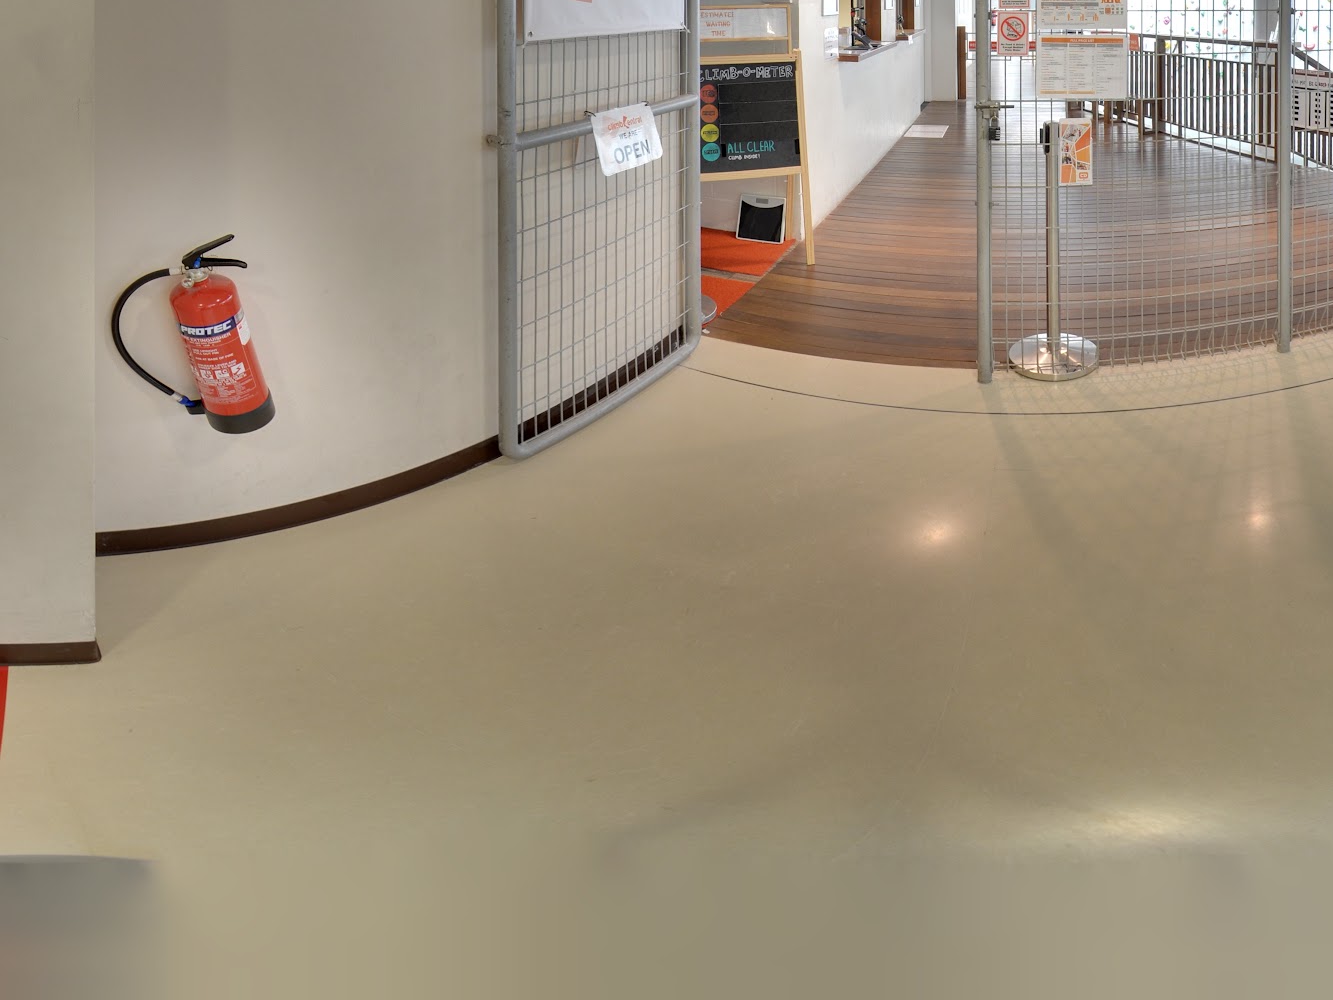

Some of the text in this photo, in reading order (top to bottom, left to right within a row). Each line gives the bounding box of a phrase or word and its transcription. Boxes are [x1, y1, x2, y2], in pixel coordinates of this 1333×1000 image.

[613, 139, 651, 165] OPEN
[727, 142, 746, 154] ALL
[746, 140, 776, 153] CLEAR
[180, 320, 231, 336] PROTEC
